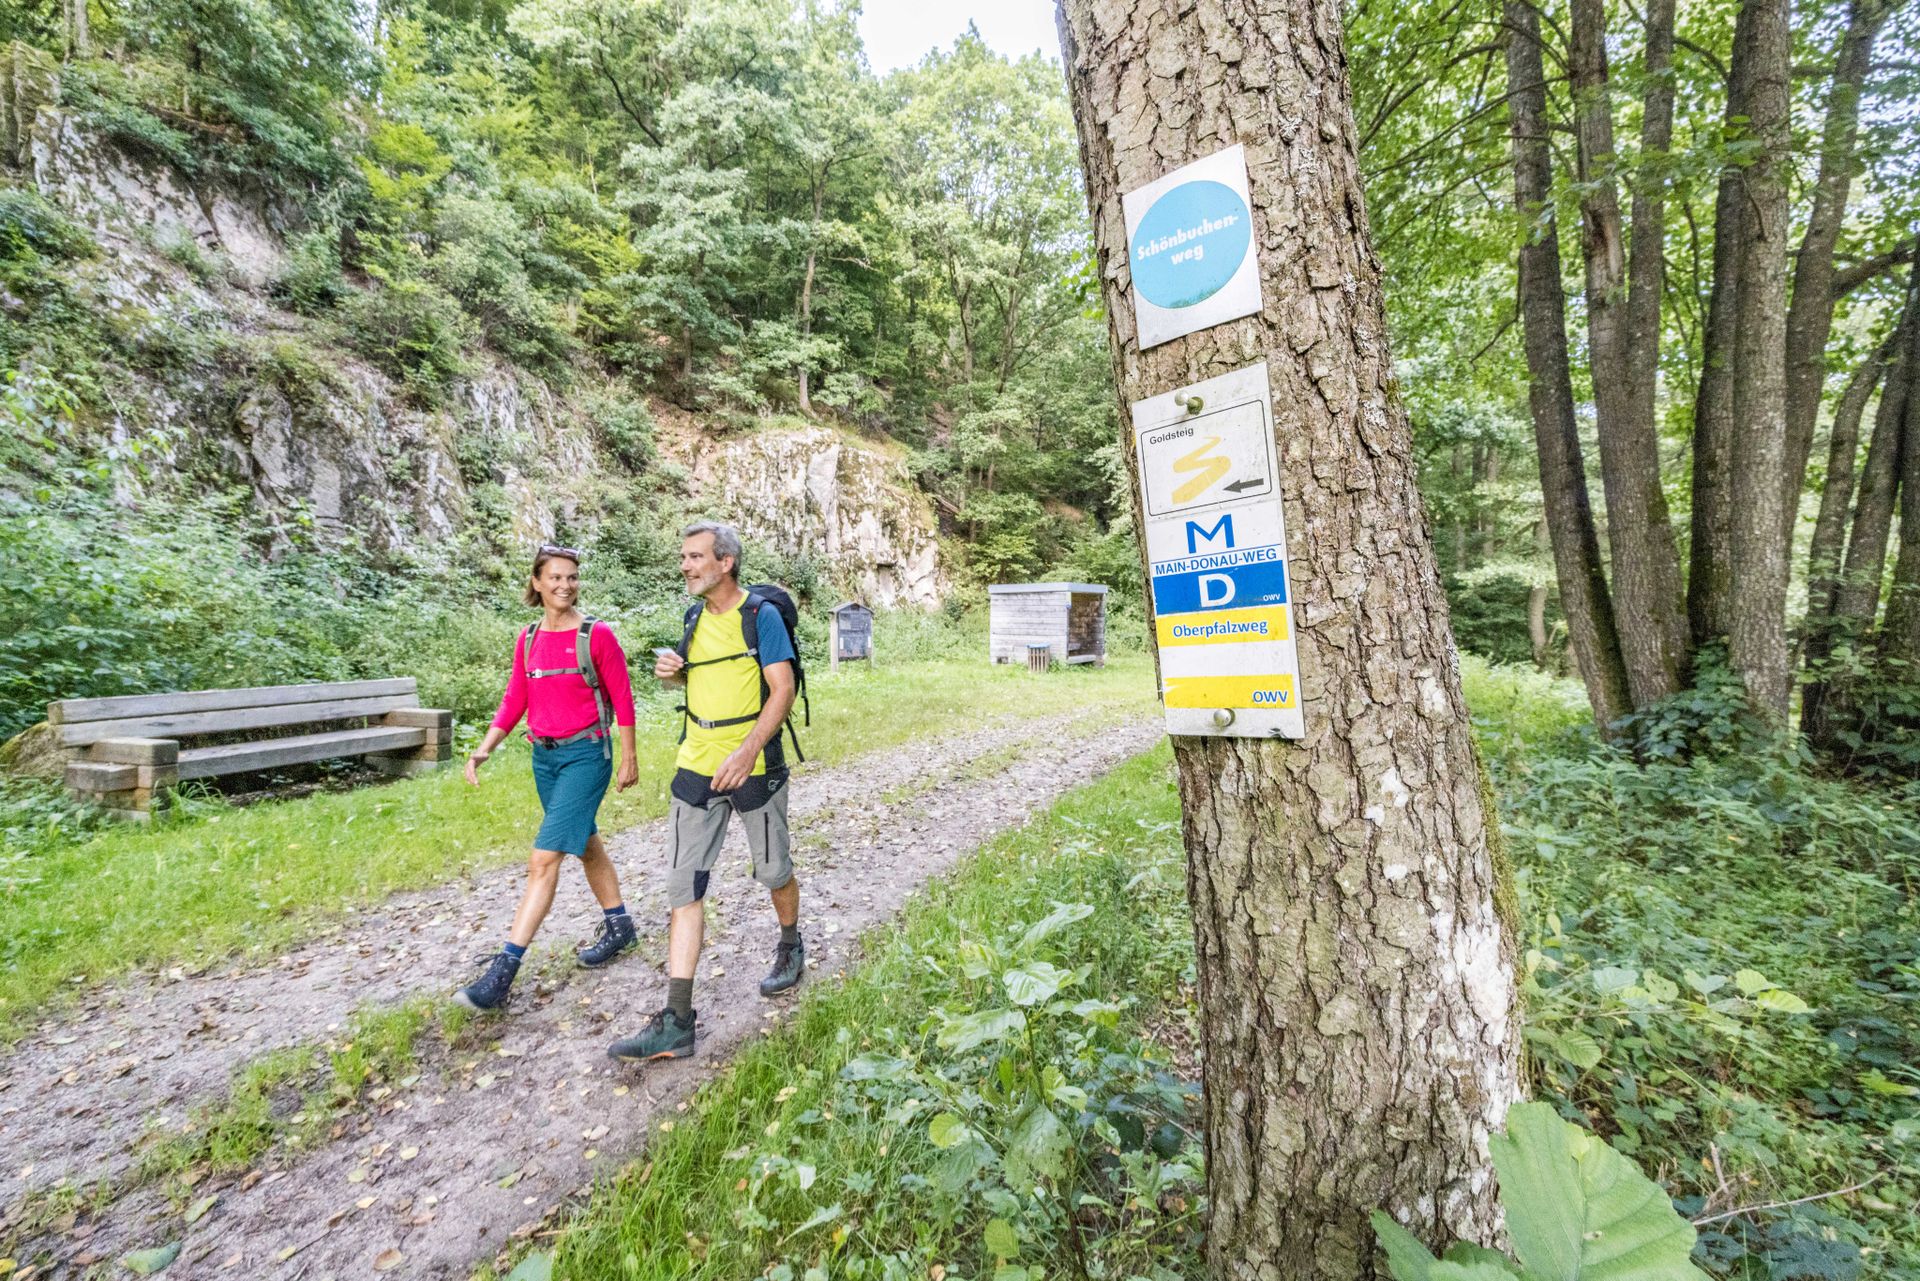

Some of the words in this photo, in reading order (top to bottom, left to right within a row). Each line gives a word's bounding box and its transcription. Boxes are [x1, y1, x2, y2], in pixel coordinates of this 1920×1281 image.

[1137, 214, 1239, 260] Schönbuchen-
[1170, 244, 1204, 265] weg
[1149, 427, 1194, 445] Goldsteig
[1186, 514, 1235, 554] M
[1155, 548, 1277, 575] MAIN-DONAU-WEG
[1198, 573, 1236, 608] D
[1263, 593, 1281, 602] OWV
[1172, 620, 1268, 638] Oberpfalzweg
[1252, 690, 1288, 703] OWV
